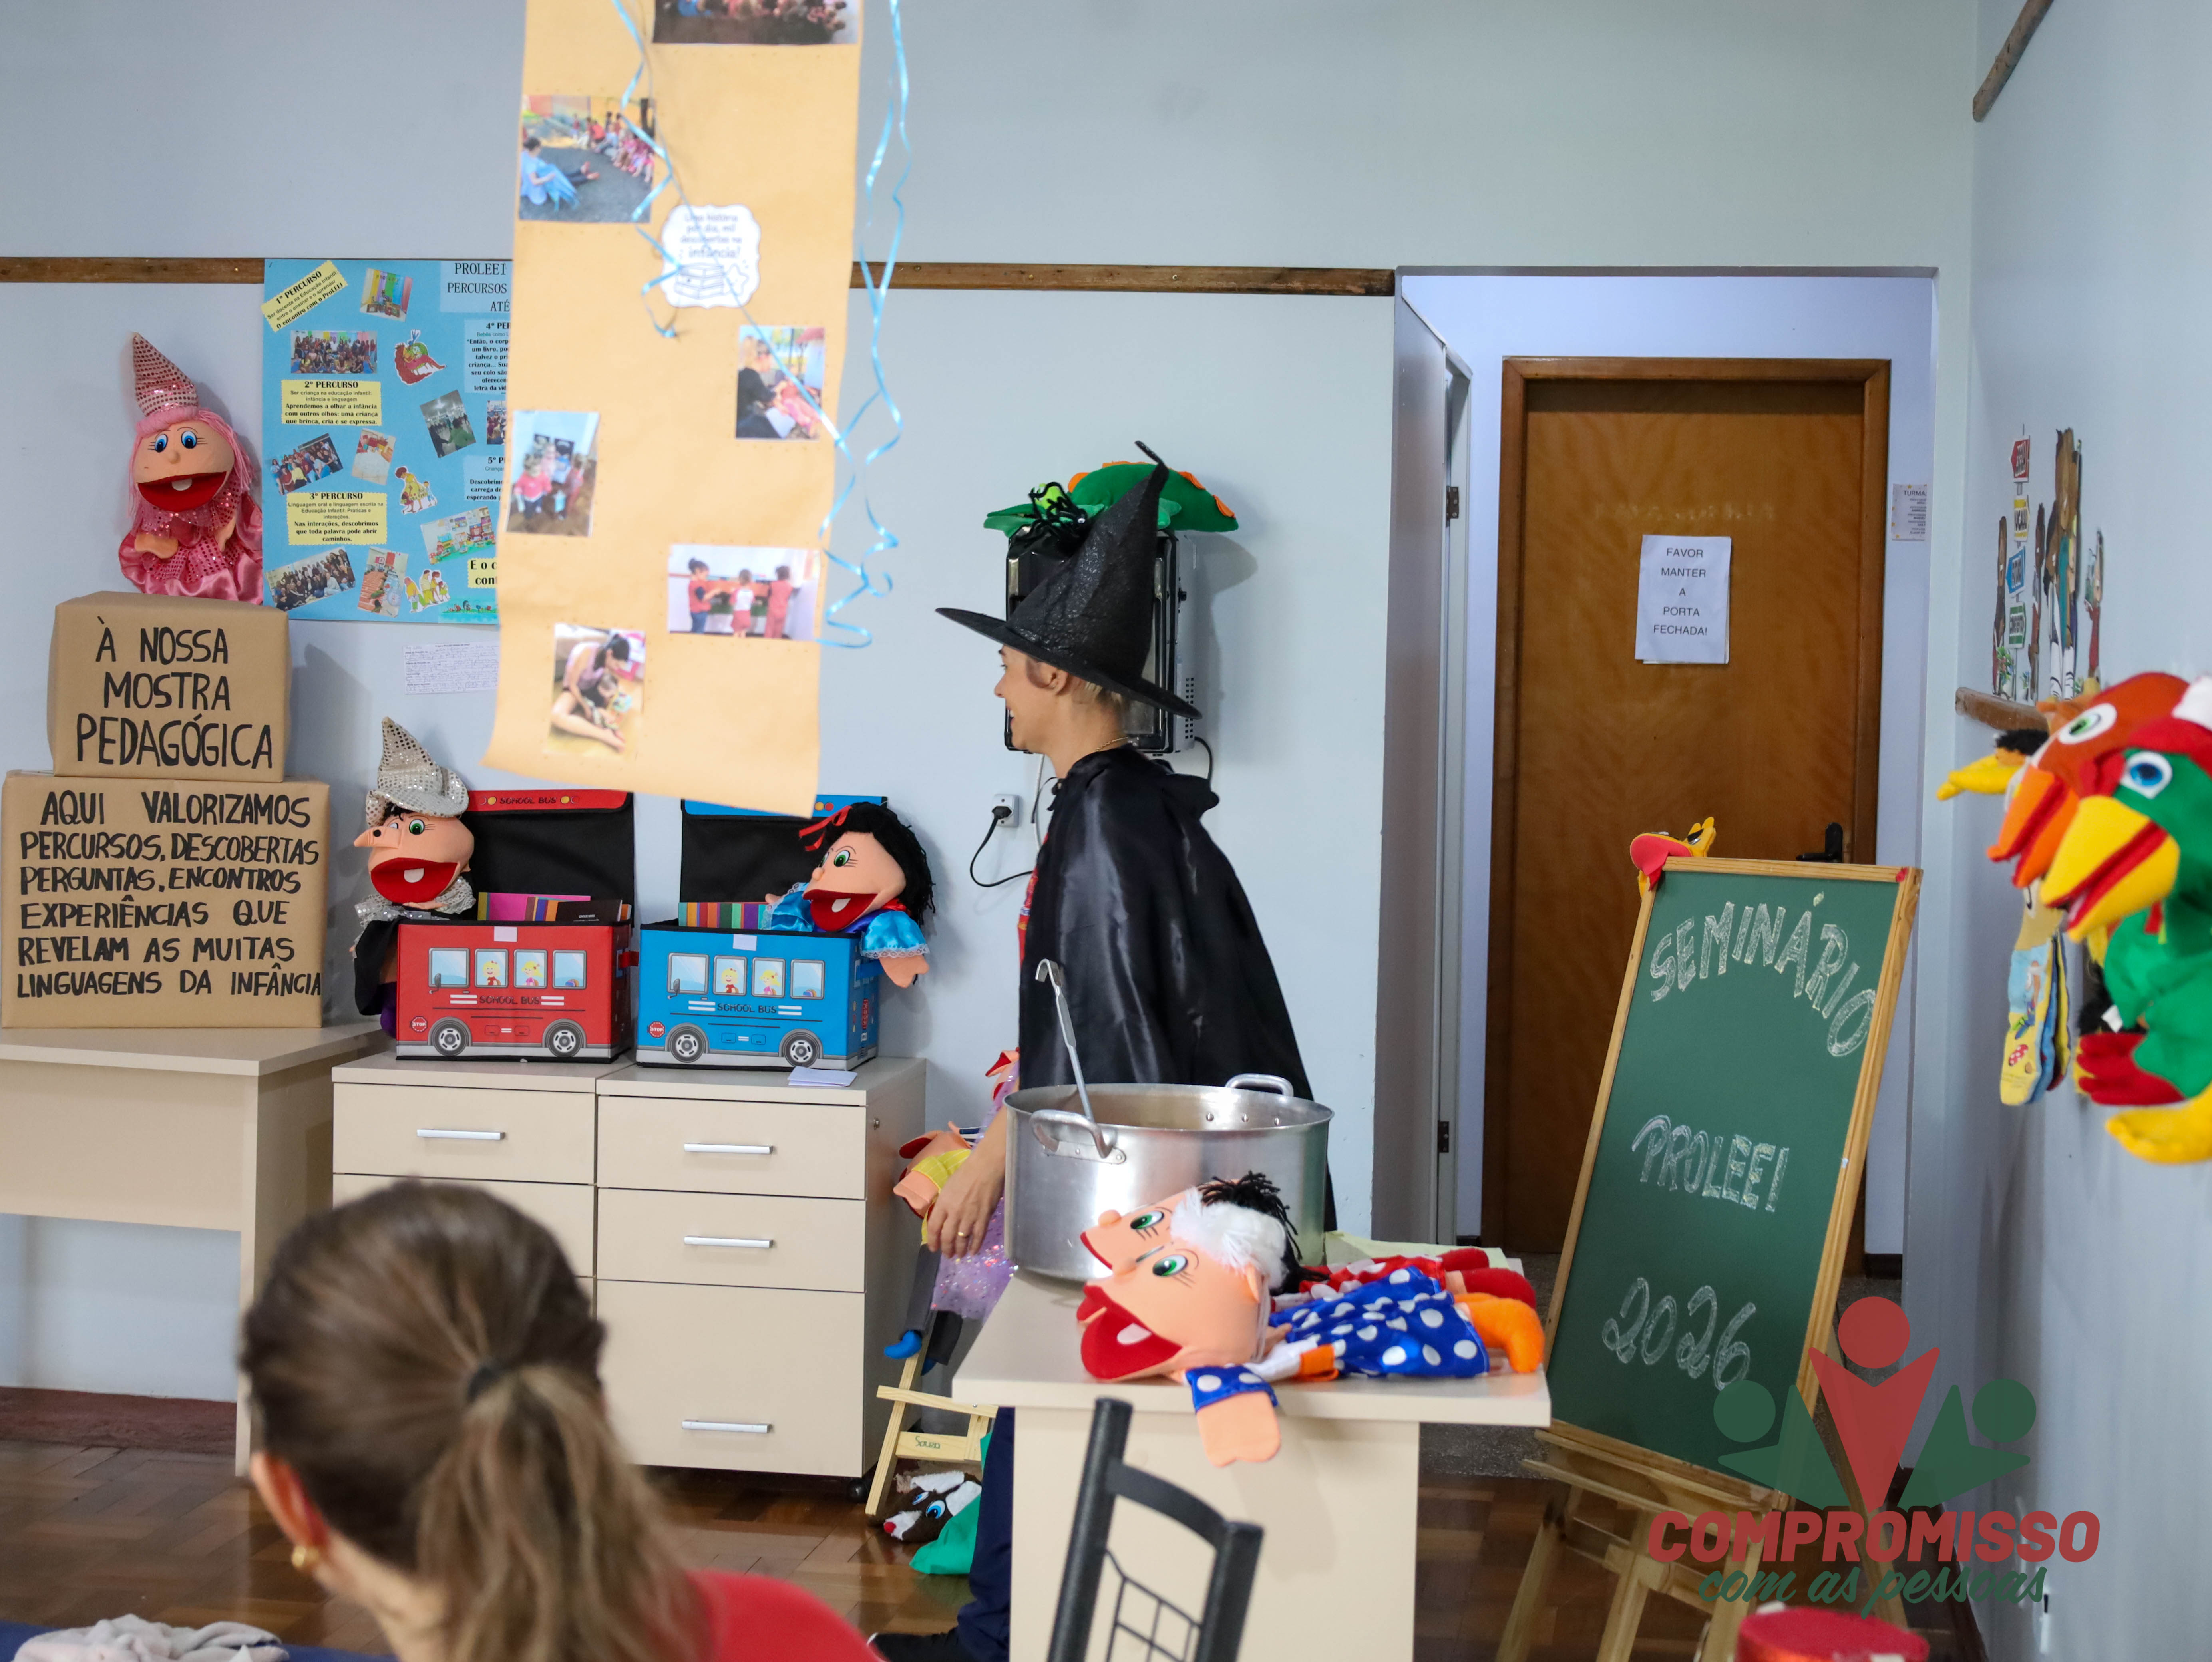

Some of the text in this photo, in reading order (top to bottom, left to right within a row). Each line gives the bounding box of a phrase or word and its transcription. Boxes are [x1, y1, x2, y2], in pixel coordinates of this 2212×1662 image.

[455, 263, 506, 275] PROLEEI
[276, 302, 294, 314] docente
[300, 283, 322, 298] Educação
[285, 271, 322, 298] PERCURSO
[448, 283, 507, 294] PERCURSOS
[277, 312, 288, 321] entre
[293, 298, 309, 310] ensinar
[317, 280, 336, 295] aprender
[283, 309, 306, 325] encontro
[307, 302, 318, 310] com
[491, 299, 510, 312] ATÉ
[471, 560, 477, 569] E
[1667, 548, 1703, 558] FAVOR
[1661, 567, 1706, 577] MANTER
[1663, 607, 1700, 616] PORTA
[95, 616, 229, 665] À NOSSA
[1653, 625, 1707, 636] FECHADA!
[103, 671, 231, 711] MOSTRA
[77, 713, 273, 769] PEDAGÓGICA
[40, 790, 312, 828] AQUI VALORIZAMOS
[20, 831, 320, 865] PERCURSOS, DESCOBERTAS
[20, 865, 301, 895] PERGUNTAS, ENCONTROS
[20, 894, 290, 930] EXPERIÊNCIAS QUE
[18, 936, 295, 967] REVELAM AS MUITAS
[17, 963, 322, 998] LINGUAGENS DA INFÂNCIA
[1649, 891, 1877, 1058] SEMINÁRIO
[521, 996, 540, 1005] BUS
[717, 1003, 777, 1014] SCHOOL BUS
[1631, 1114, 1790, 1212] PROLEEI
[1601, 1276, 1757, 1392] 2026
